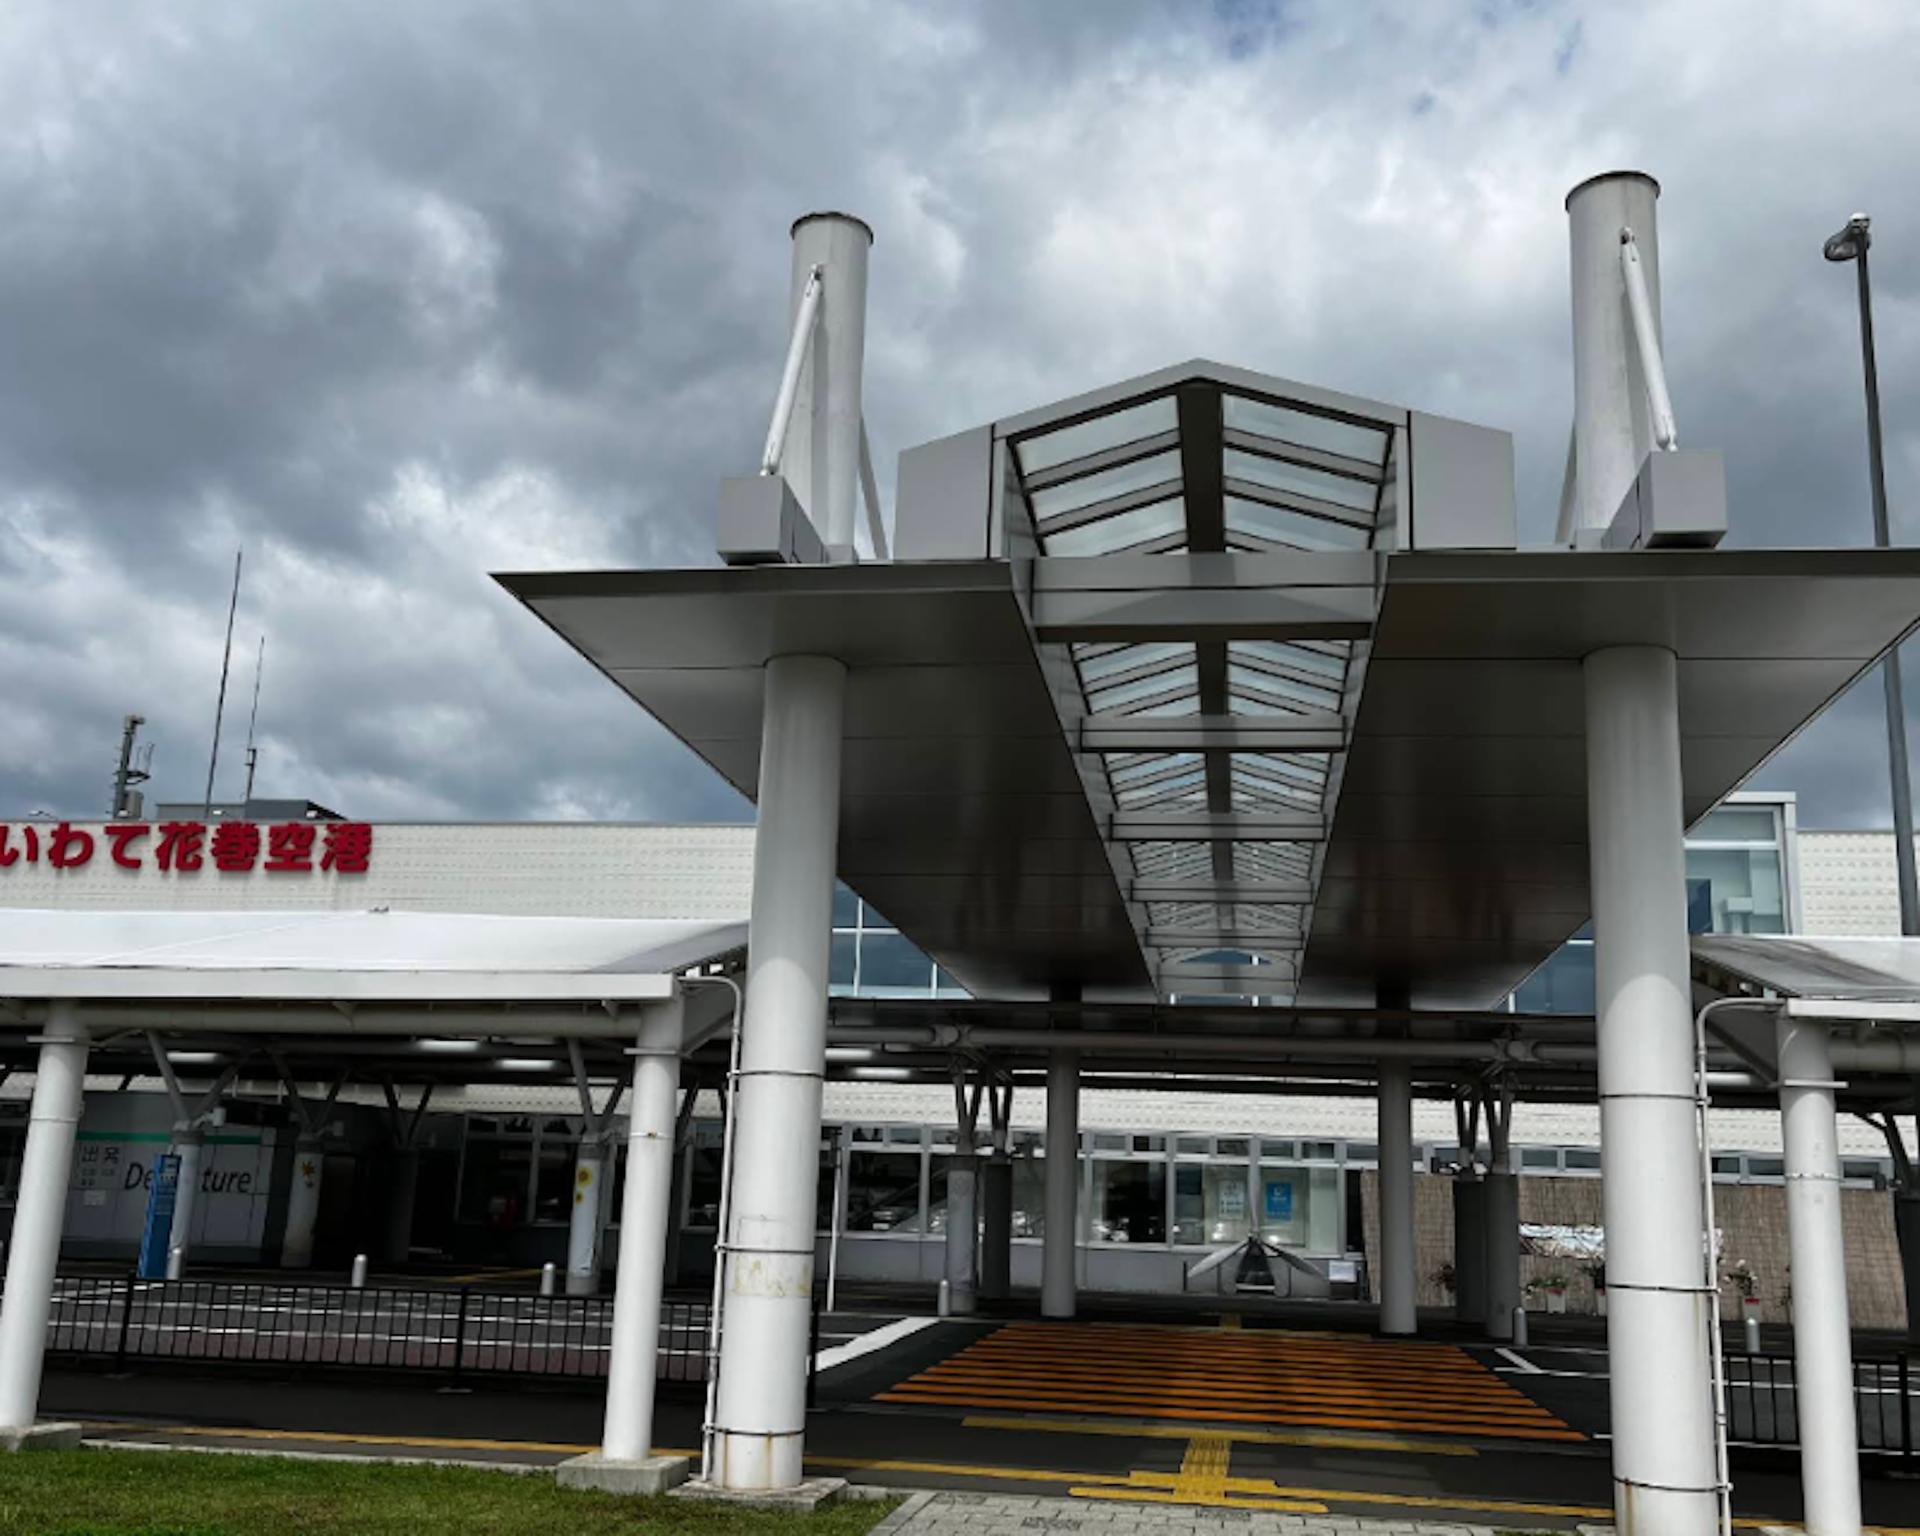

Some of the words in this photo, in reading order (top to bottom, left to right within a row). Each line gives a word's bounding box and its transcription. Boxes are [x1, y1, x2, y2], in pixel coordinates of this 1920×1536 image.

[0, 821, 372, 873] いわて花巻空港
[124, 1161, 252, 1193] Deture
